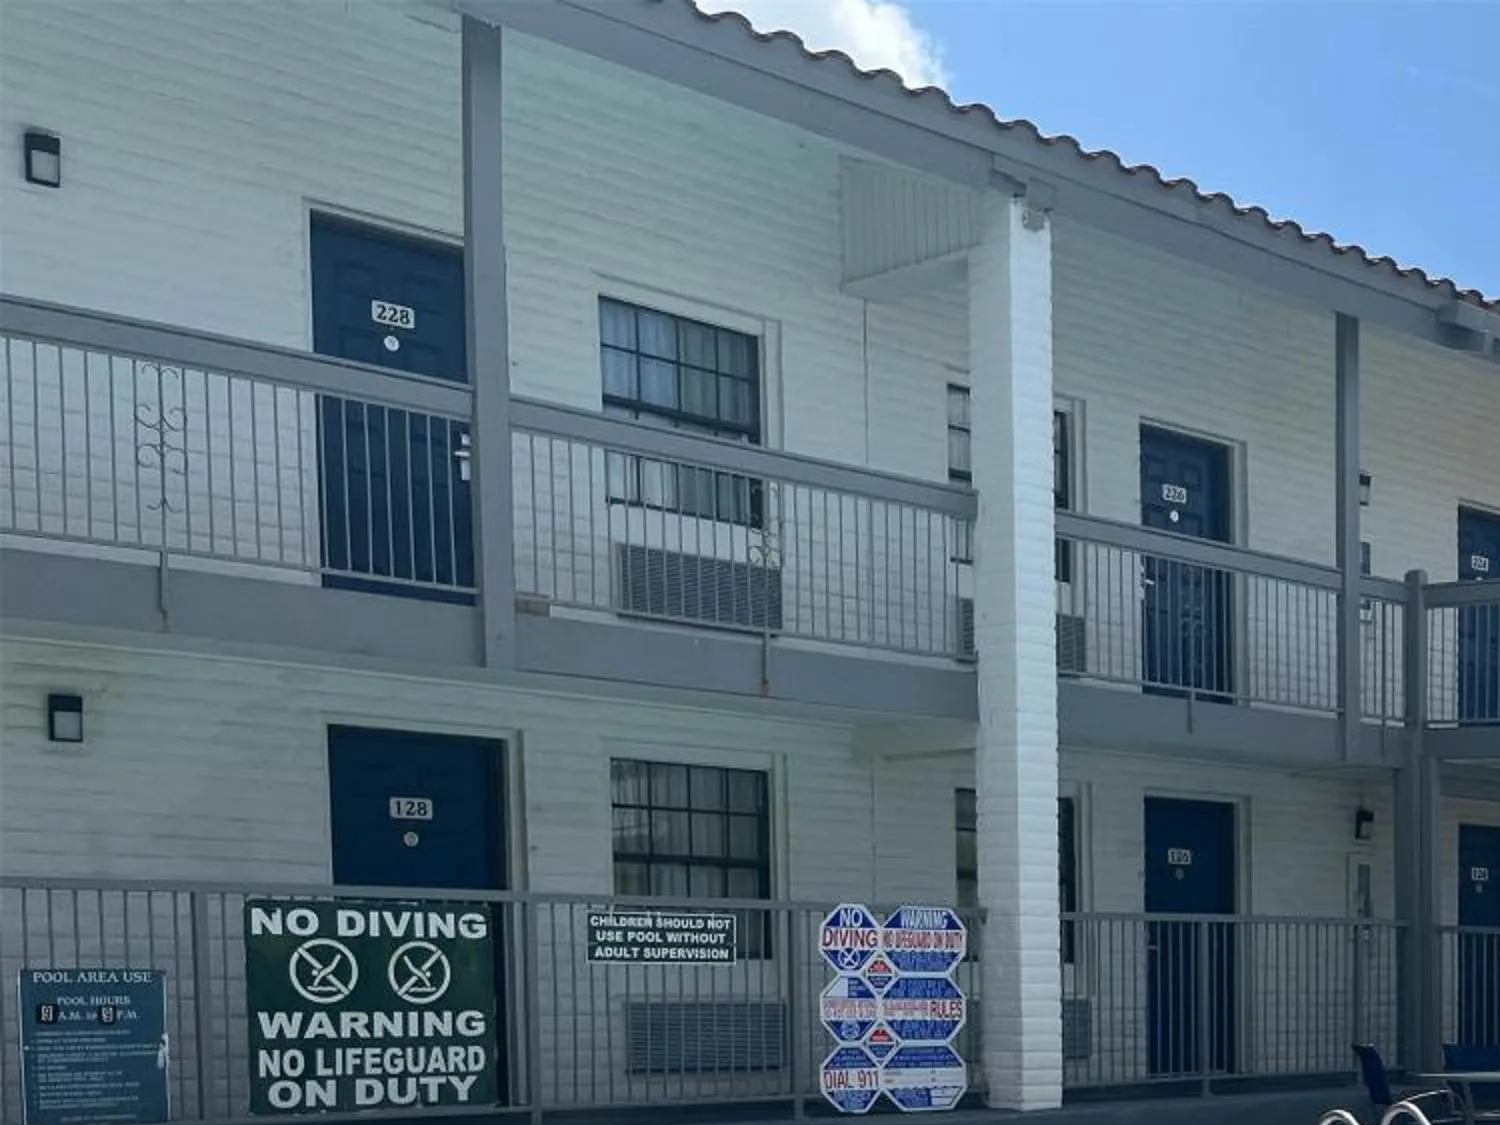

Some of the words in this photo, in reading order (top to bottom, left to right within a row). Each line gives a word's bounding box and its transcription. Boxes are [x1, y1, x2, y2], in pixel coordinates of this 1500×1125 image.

[376, 304, 411, 325] 228
[395, 800, 428, 816] 128
[250, 908, 319, 936] NO
[337, 910, 487, 939] DIVING
[590, 915, 652, 928] CHILDREN
[655, 916, 704, 929] SHOULD
[707, 919, 731, 929] NOT
[839, 910, 862, 927] NO
[595, 930, 624, 942] USE
[627, 931, 663, 943] POOL
[666, 932, 726, 944] WITHOUT
[823, 930, 877, 948] DIVING
[595, 946, 640, 958] ADULT
[643, 947, 729, 960] SUPERVISION
[33, 972, 73, 983] POOL
[77, 972, 119, 983] AREA
[123, 972, 152, 982] USE
[257, 1011, 486, 1040] WARNING
[259, 1049, 304, 1078] NO
[315, 1045, 486, 1077] LIFEGUARD
[824, 1070, 849, 1089] DIAL
[857, 1070, 879, 1088] 911
[267, 1080, 337, 1109] ON
[354, 1075, 478, 1105] DUTY
